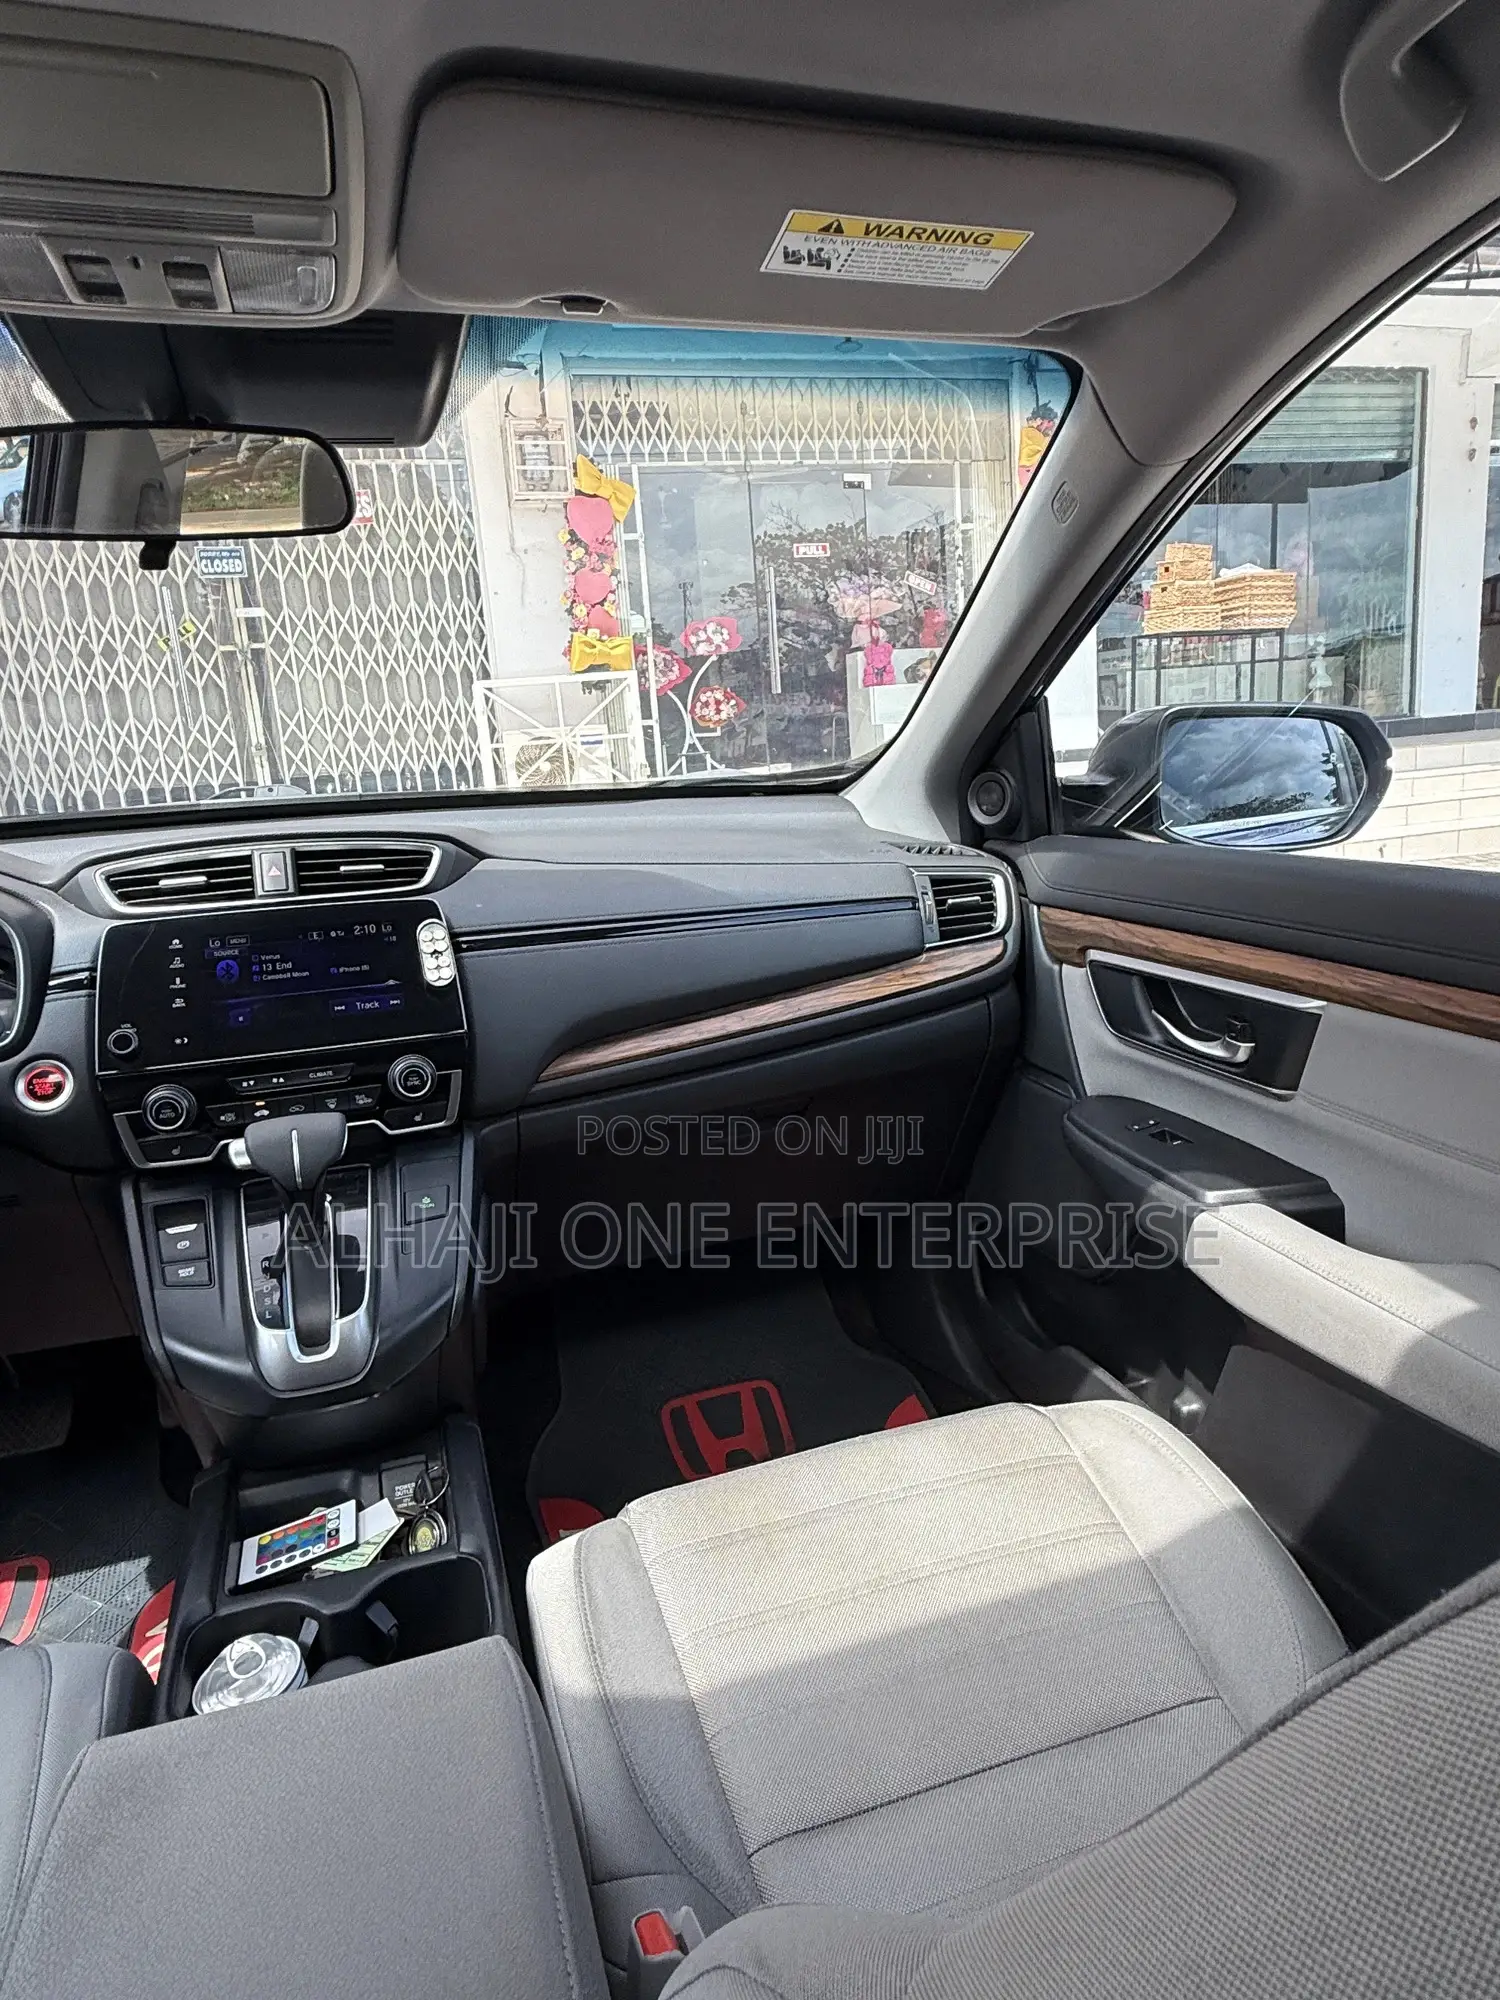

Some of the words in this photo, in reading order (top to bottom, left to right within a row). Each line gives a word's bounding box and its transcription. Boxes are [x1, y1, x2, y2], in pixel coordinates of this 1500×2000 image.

[864, 223, 994, 245] WARNING
[804, 235, 837, 244] EVEN
[841, 238, 870, 248] WITH
[871, 241, 936, 253] ADVANCED
[940, 246, 958, 254] AIR
[960, 248, 992, 257] BAGS
[799, 545, 825, 556] PULL
[201, 559, 243, 573] CLOSED
[353, 923, 377, 935] 2:10
[209, 939, 221, 948] Lo
[213, 949, 240, 957] SOURCE
[262, 963, 273, 972] 13
[276, 961, 293, 970] End
[356, 1001, 380, 1010] Track
[309, 1071, 334, 1079] CLIMATE
[262, 1260, 270, 1269] R
[263, 1284, 271, 1293] D
[264, 1297, 272, 1306] S
[265, 1310, 272, 1319] L
[394, 1482, 416, 1492] POWER
[394, 1487, 414, 1497] OUTLE
